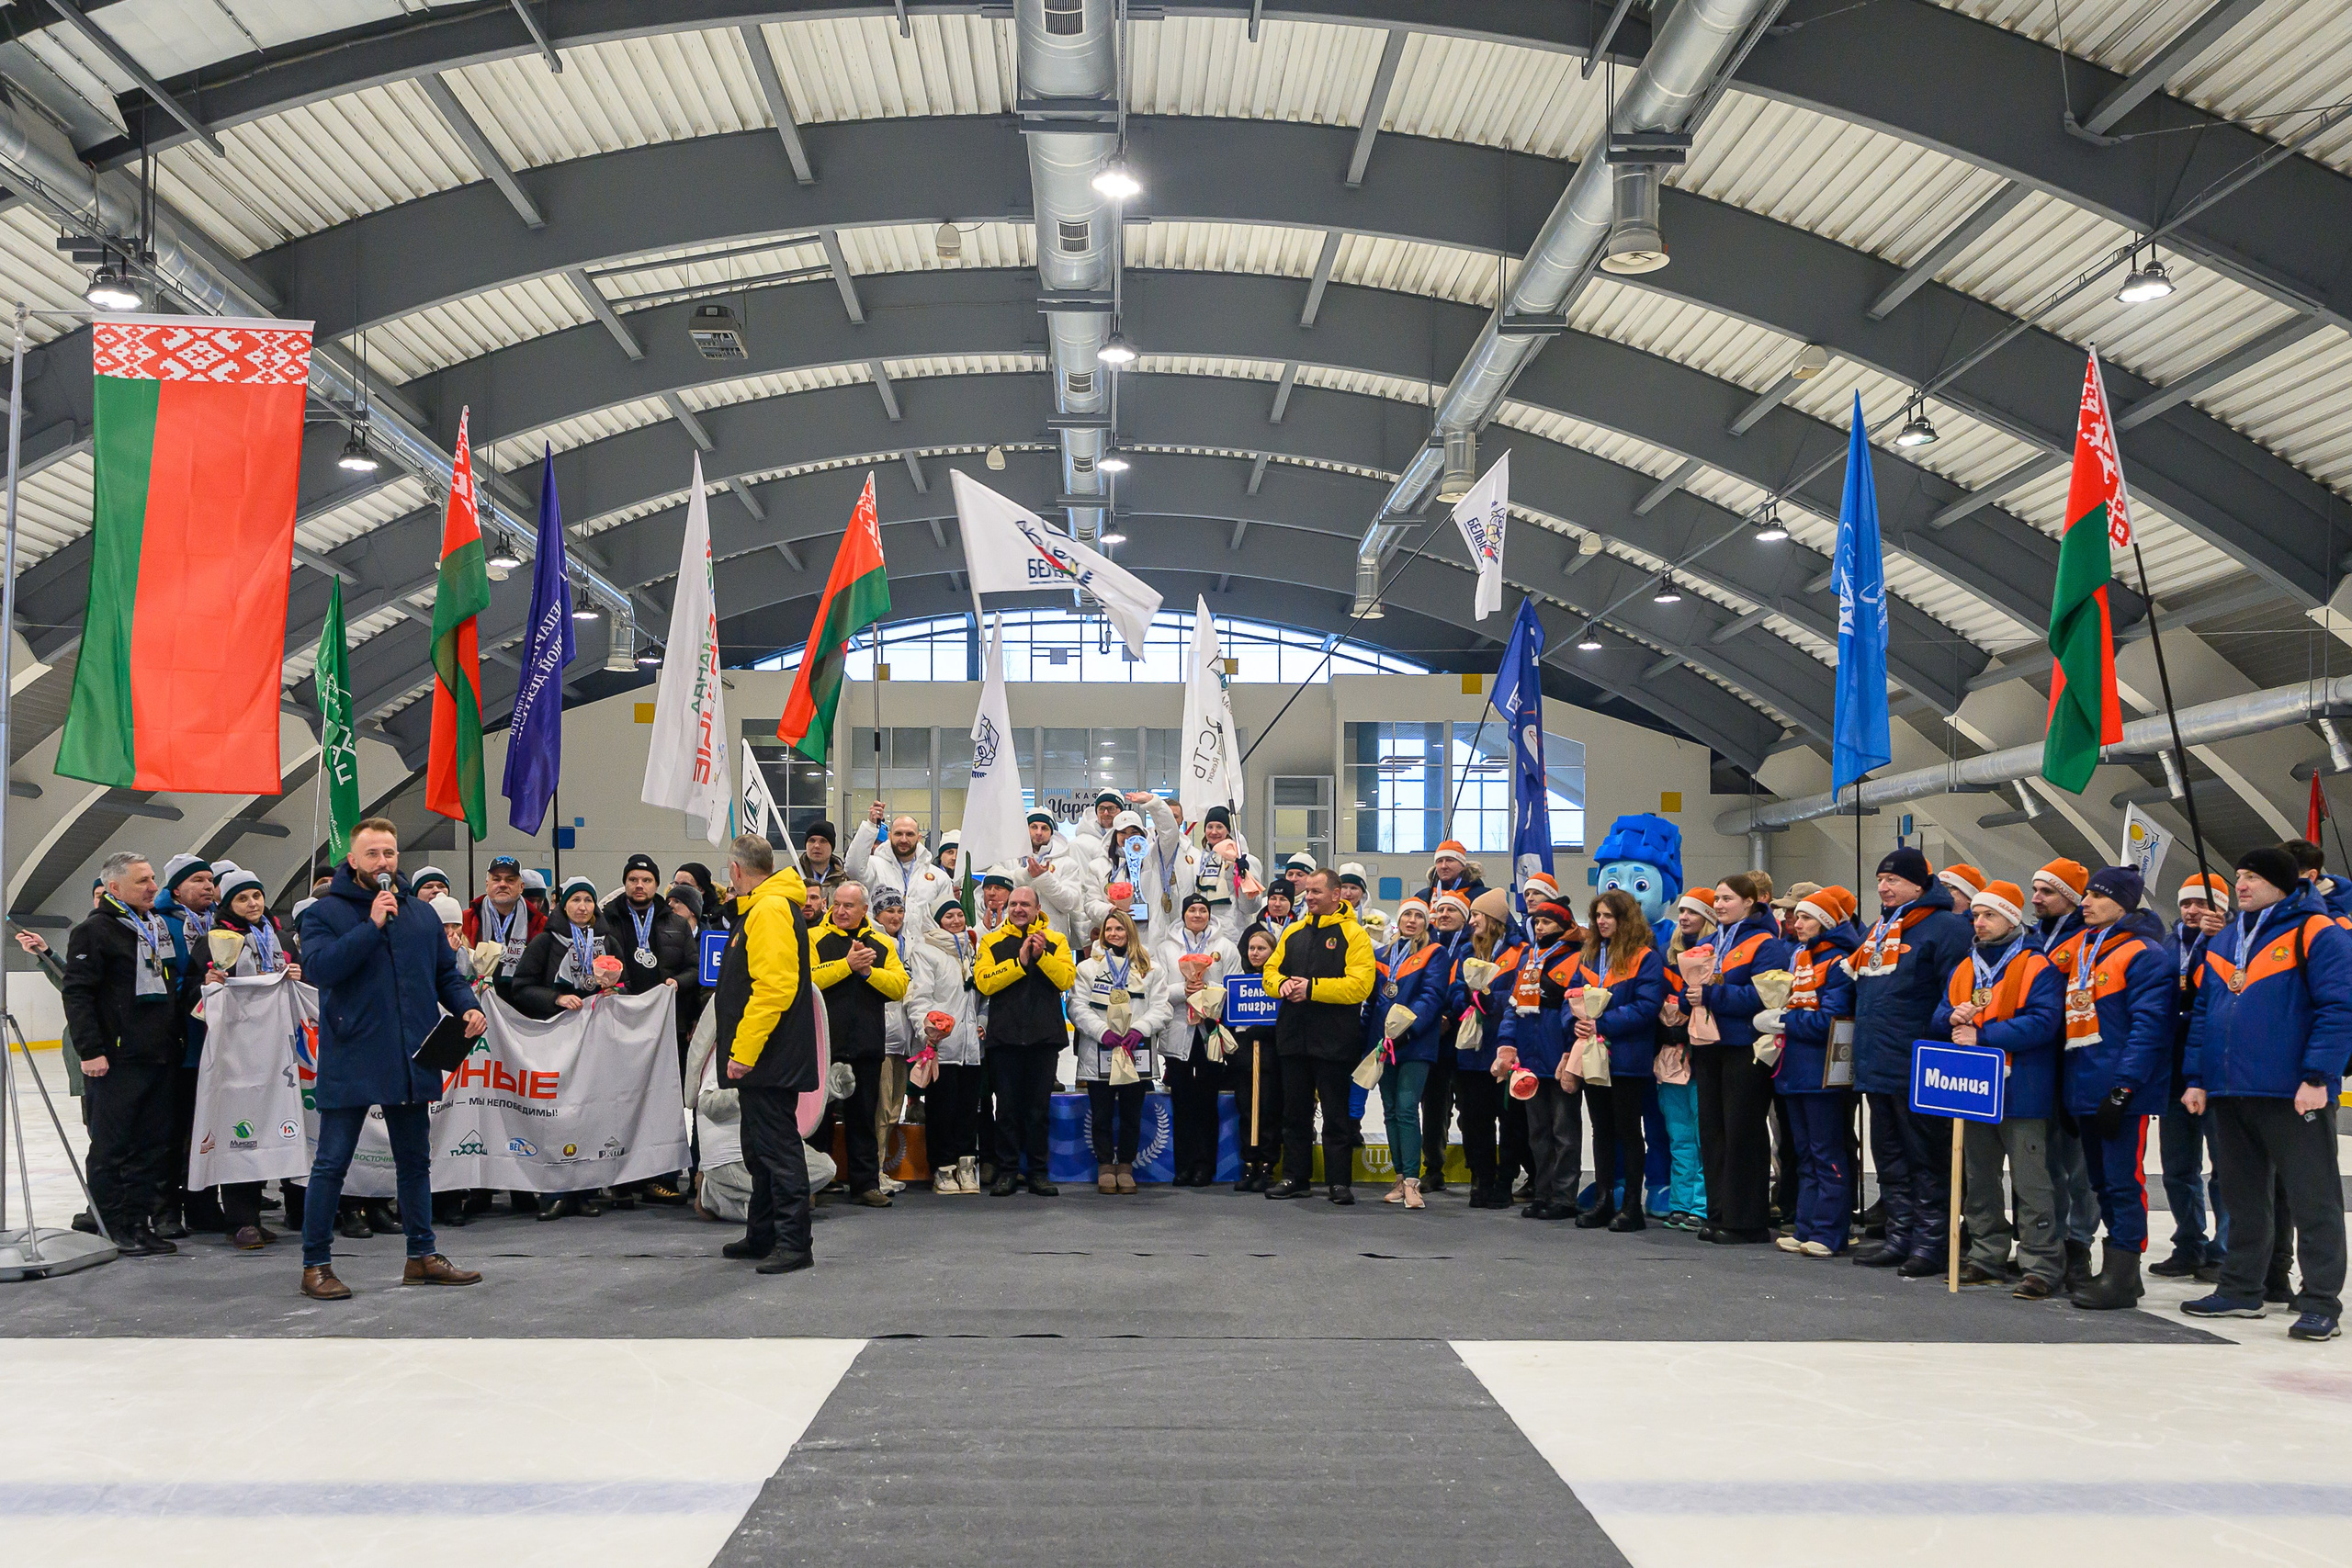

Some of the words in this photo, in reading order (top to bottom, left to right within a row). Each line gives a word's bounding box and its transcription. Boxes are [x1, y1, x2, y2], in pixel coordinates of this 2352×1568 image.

[1075, 792, 1099, 800] КАФ
[1239, 984, 1269, 998] Белы
[1238, 1000, 1276, 1016] тигры
[1924, 1067, 1990, 1096] Молния
[469, 1097, 485, 1106] МЫ
[487, 1099, 559, 1117] НЕПОБЕДИМЫ!
[354, 1153, 395, 1163] ВОСТОЧН
